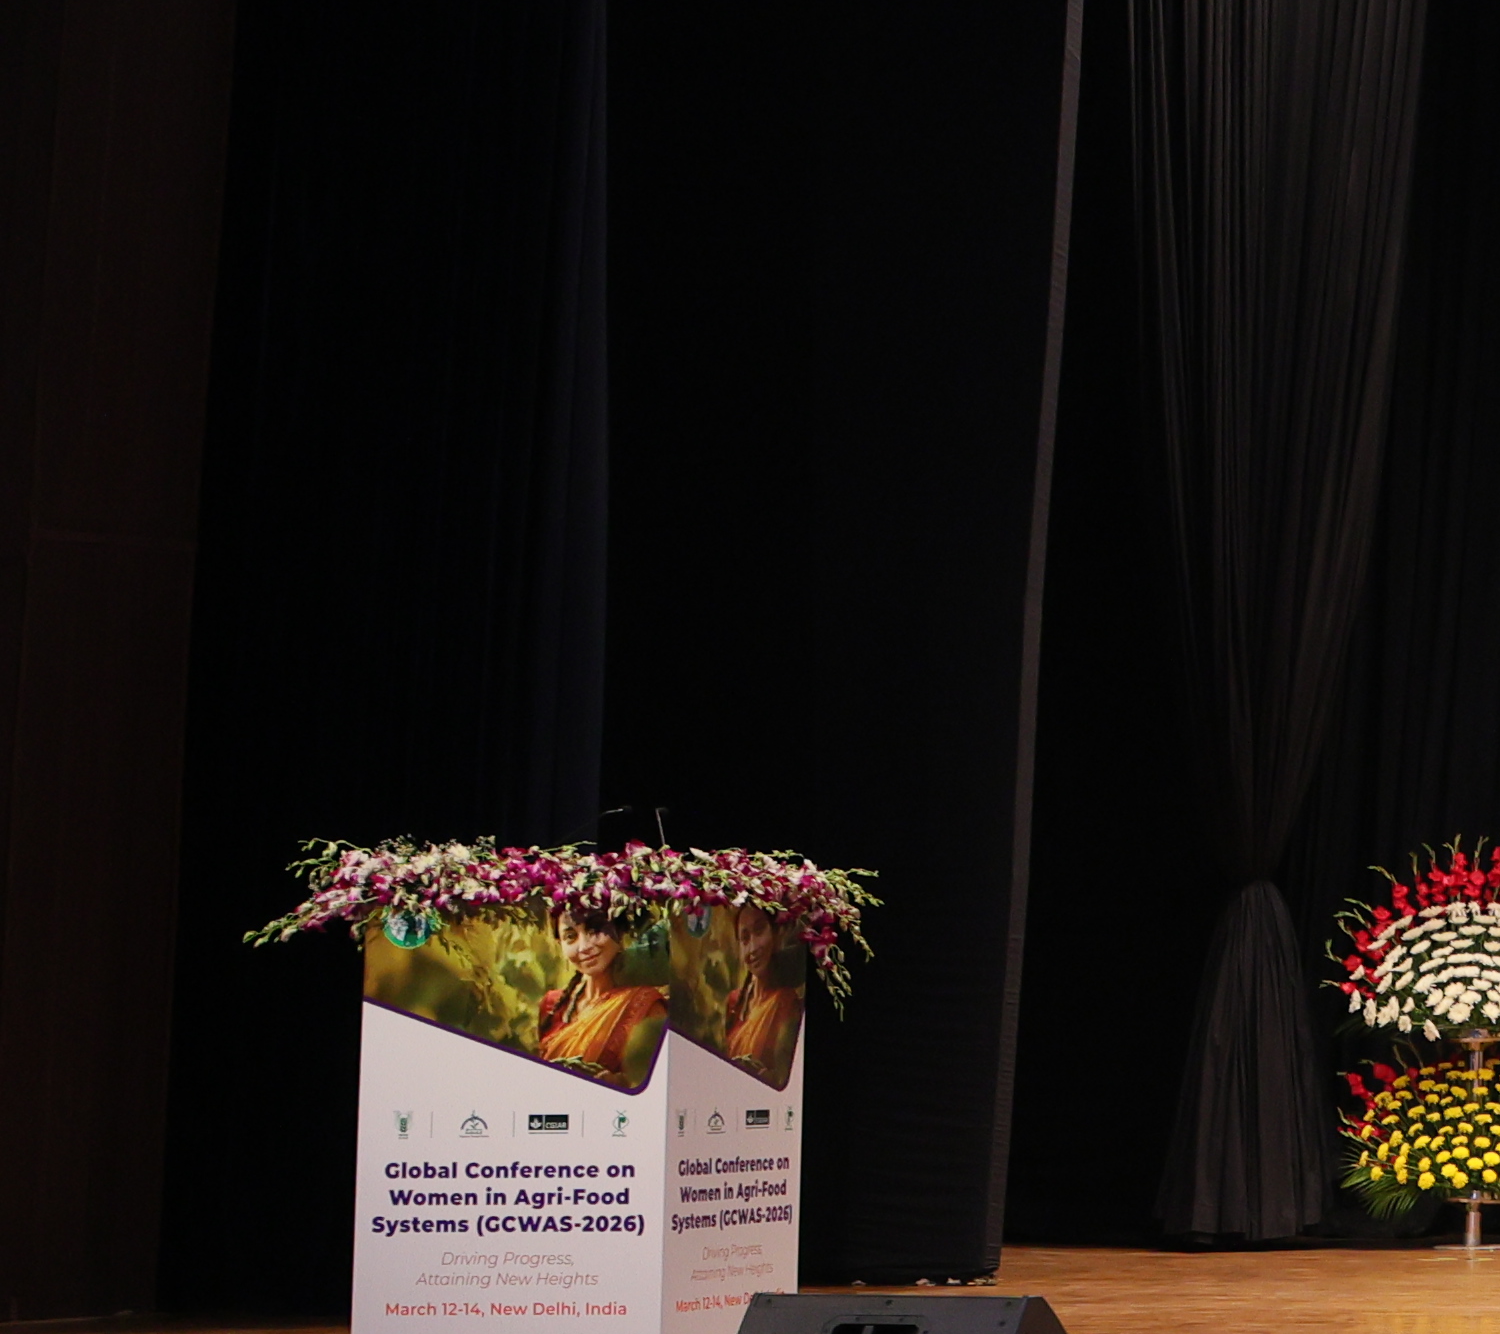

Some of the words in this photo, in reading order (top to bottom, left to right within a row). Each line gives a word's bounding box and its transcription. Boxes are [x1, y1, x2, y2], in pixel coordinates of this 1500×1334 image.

[385, 1162, 457, 1179] Global
[465, 1161, 599, 1178] Conference
[607, 1165, 635, 1178] on
[389, 1190, 477, 1205] Women
[486, 1187, 506, 1205] in
[514, 1187, 629, 1209] Agri-Food
[372, 1216, 469, 1237] Systems
[477, 1215, 644, 1236] (GCWAS-2026)
